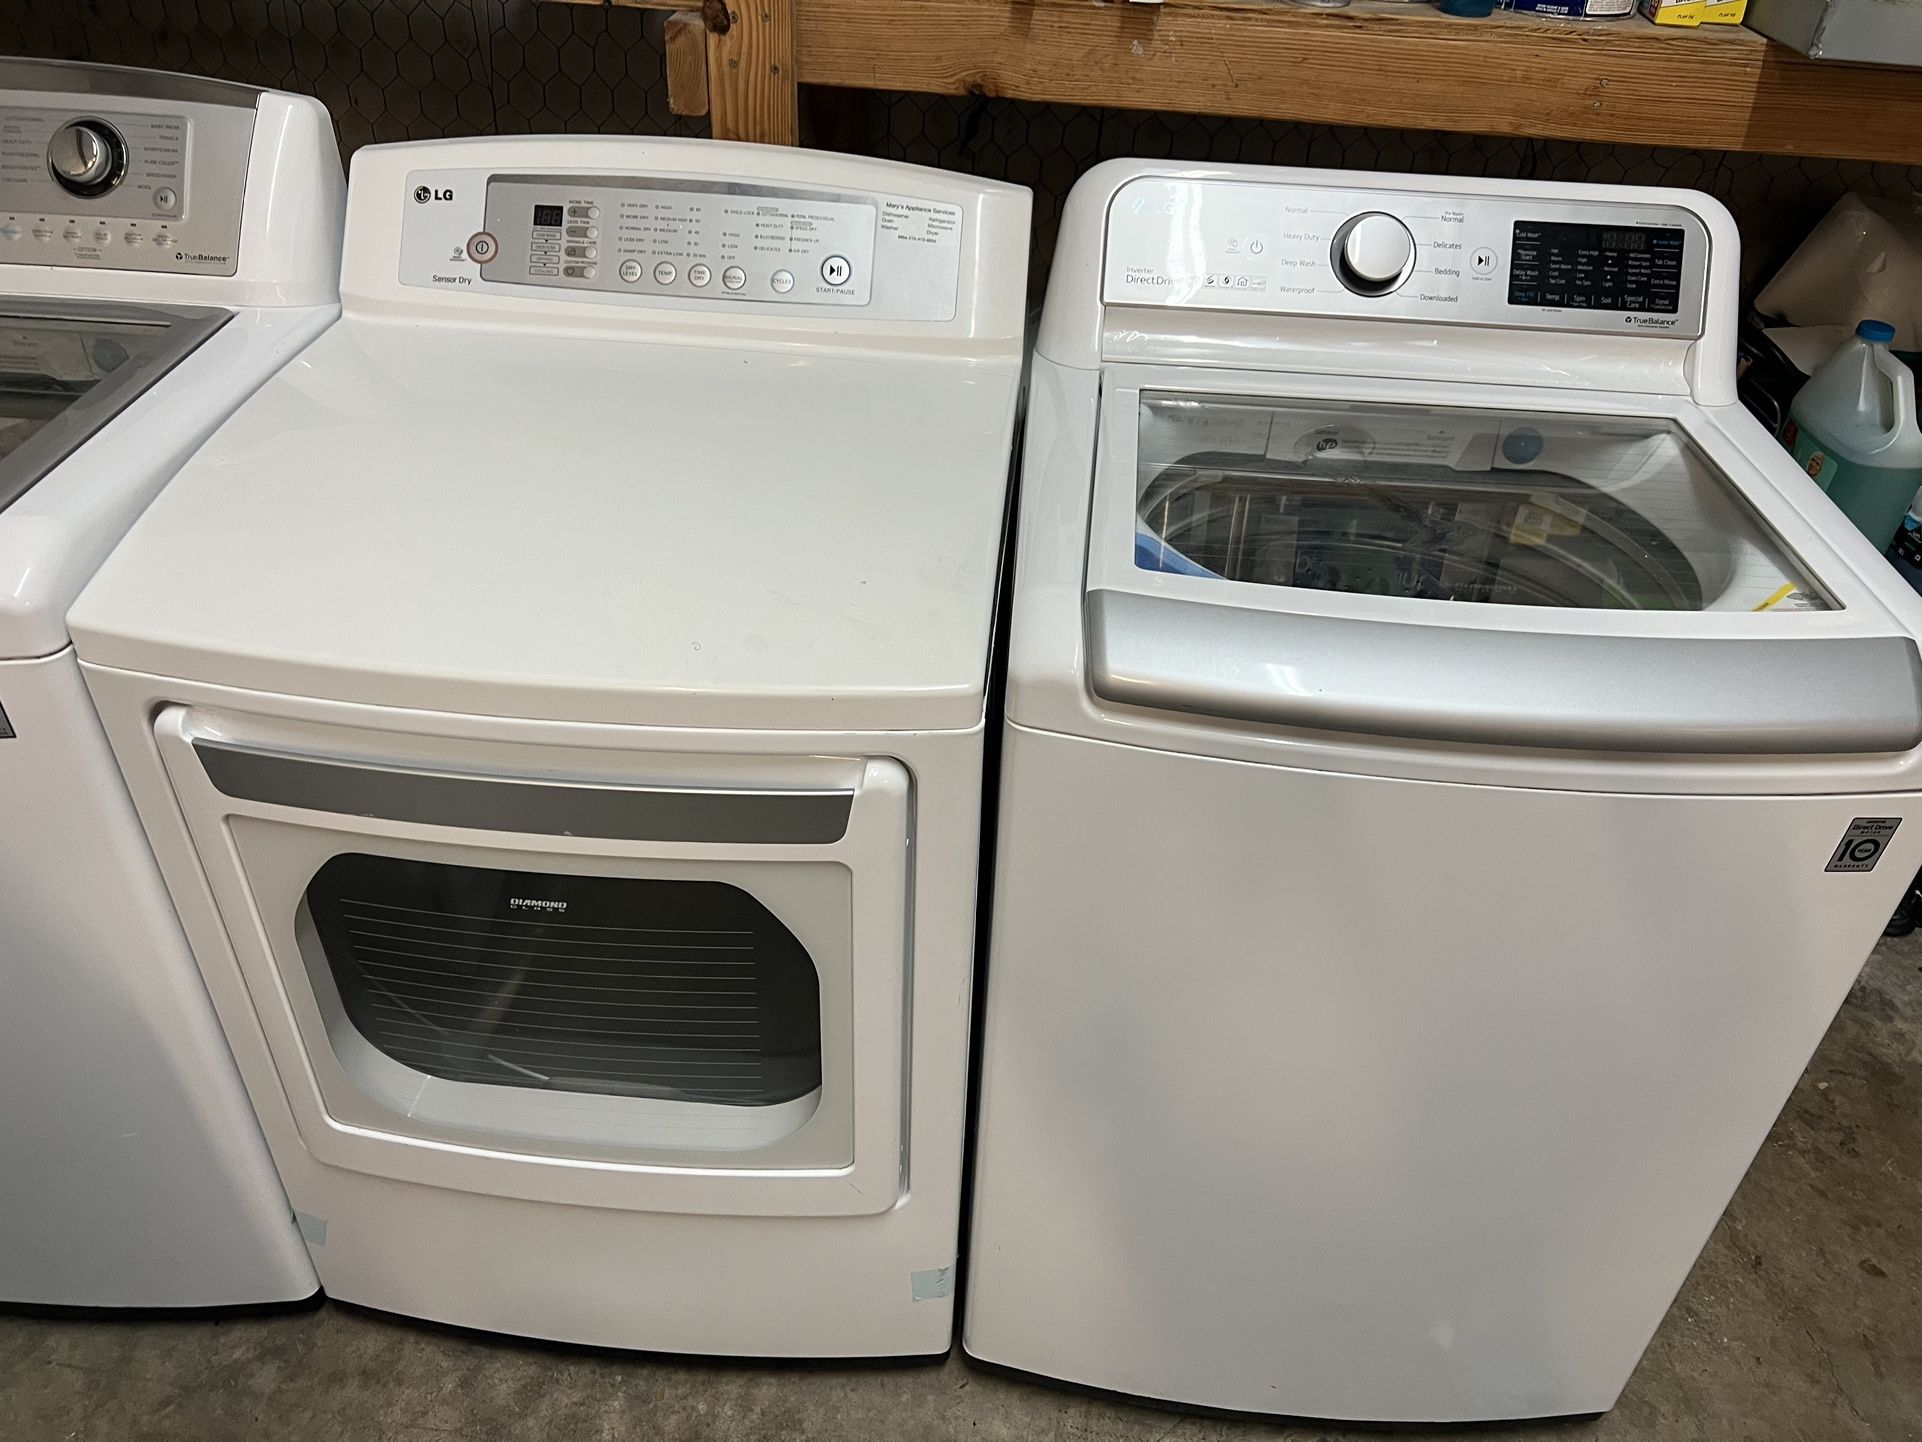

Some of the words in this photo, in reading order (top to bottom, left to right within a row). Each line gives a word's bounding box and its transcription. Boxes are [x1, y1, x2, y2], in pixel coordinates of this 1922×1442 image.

[434, 189, 453, 201] LG
[905, 204, 931, 212] Appliance
[1286, 205, 1308, 213] Normal
[1441, 215, 1464, 223] Normal
[1284, 232, 1302, 241] Heavy
[1304, 233, 1319, 242] Duty
[1433, 241, 1461, 250] Delicates
[1282, 259, 1297, 267] Deep
[1126, 266, 1154, 274] Inverter
[1434, 268, 1460, 278] Bedding
[432, 275, 457, 283] Sensor
[459, 276, 472, 285] Dry
[816, 287, 855, 296] START/PAUSE
[1280, 286, 1315, 295] Waterproof
[1420, 293, 1458, 303] Downloaded
[1837, 839, 1880, 862] 10
[510, 898, 567, 909] DIAMOND
